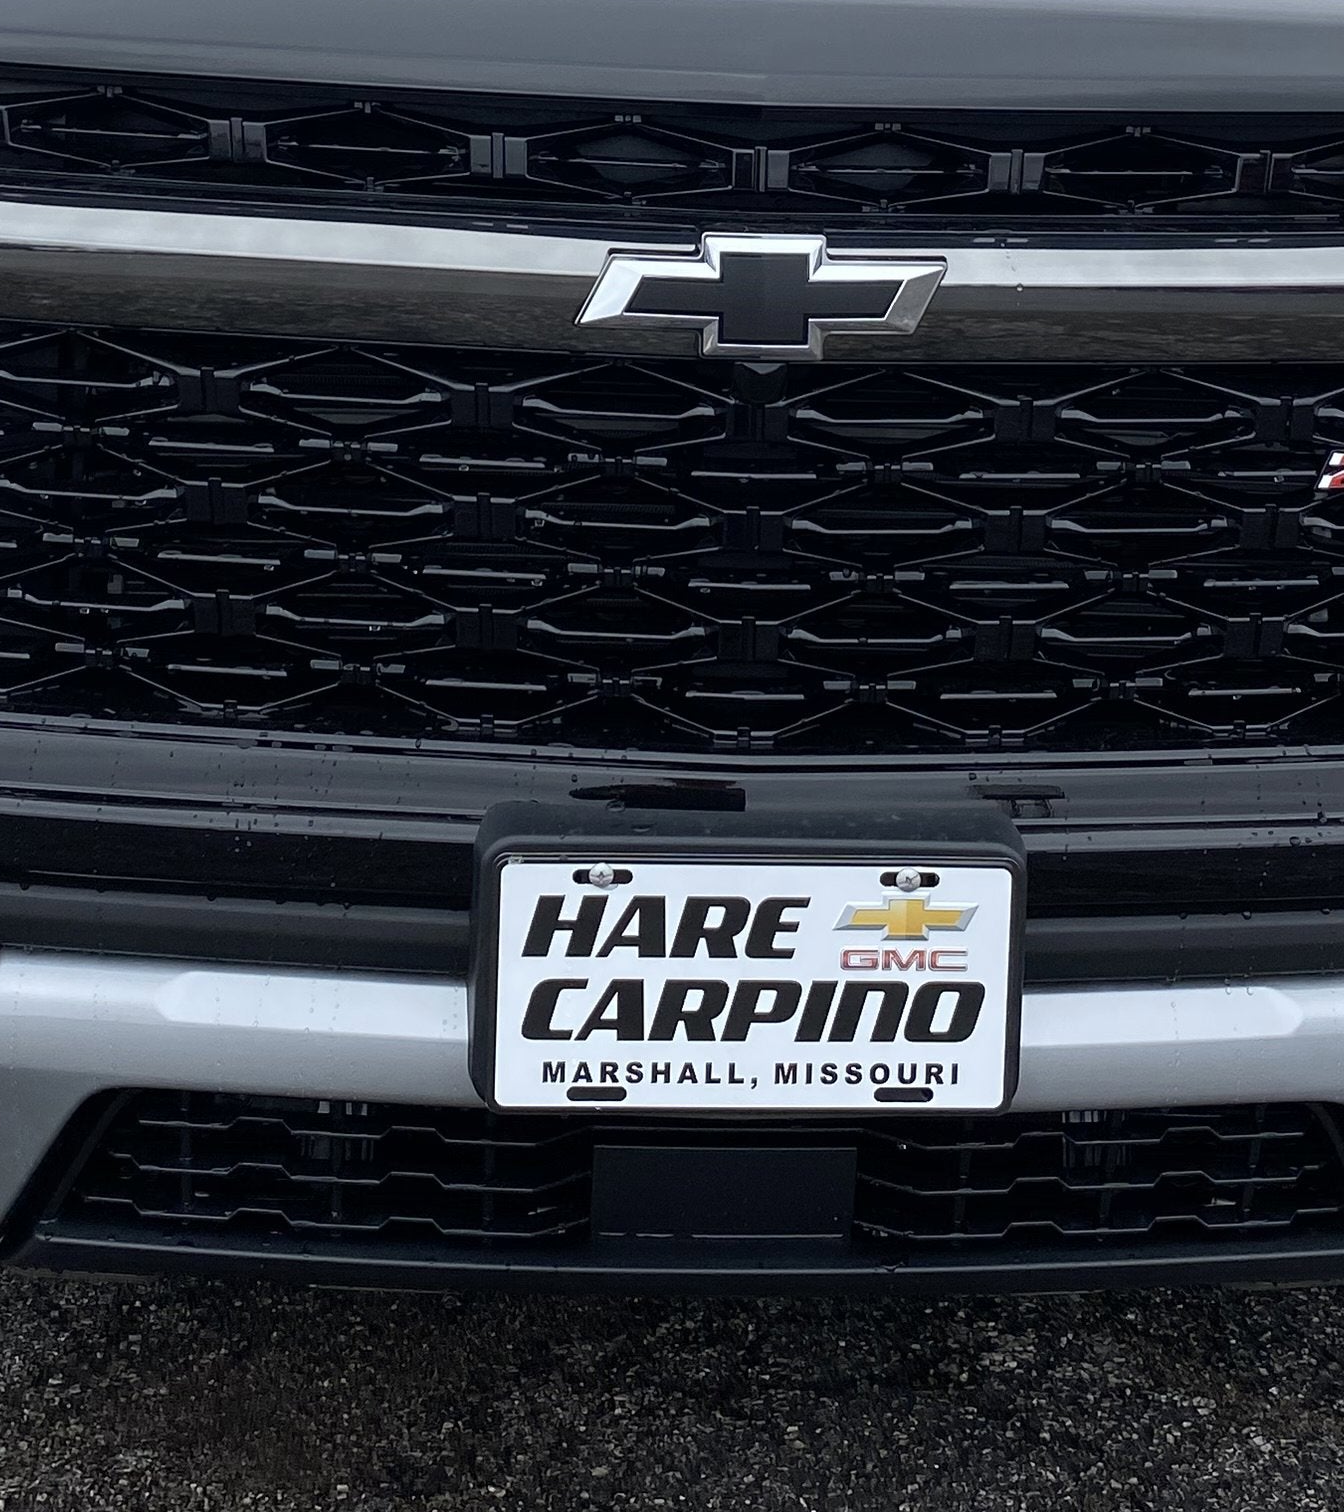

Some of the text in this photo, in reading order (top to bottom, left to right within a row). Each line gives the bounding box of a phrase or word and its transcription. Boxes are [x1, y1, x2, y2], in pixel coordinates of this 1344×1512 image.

[520, 894, 811, 959] HARE
[840, 947, 969, 972] GMC
[520, 978, 986, 1043] CARPINO
[542, 1061, 959, 1089] MARSHALL, MISSOURI
